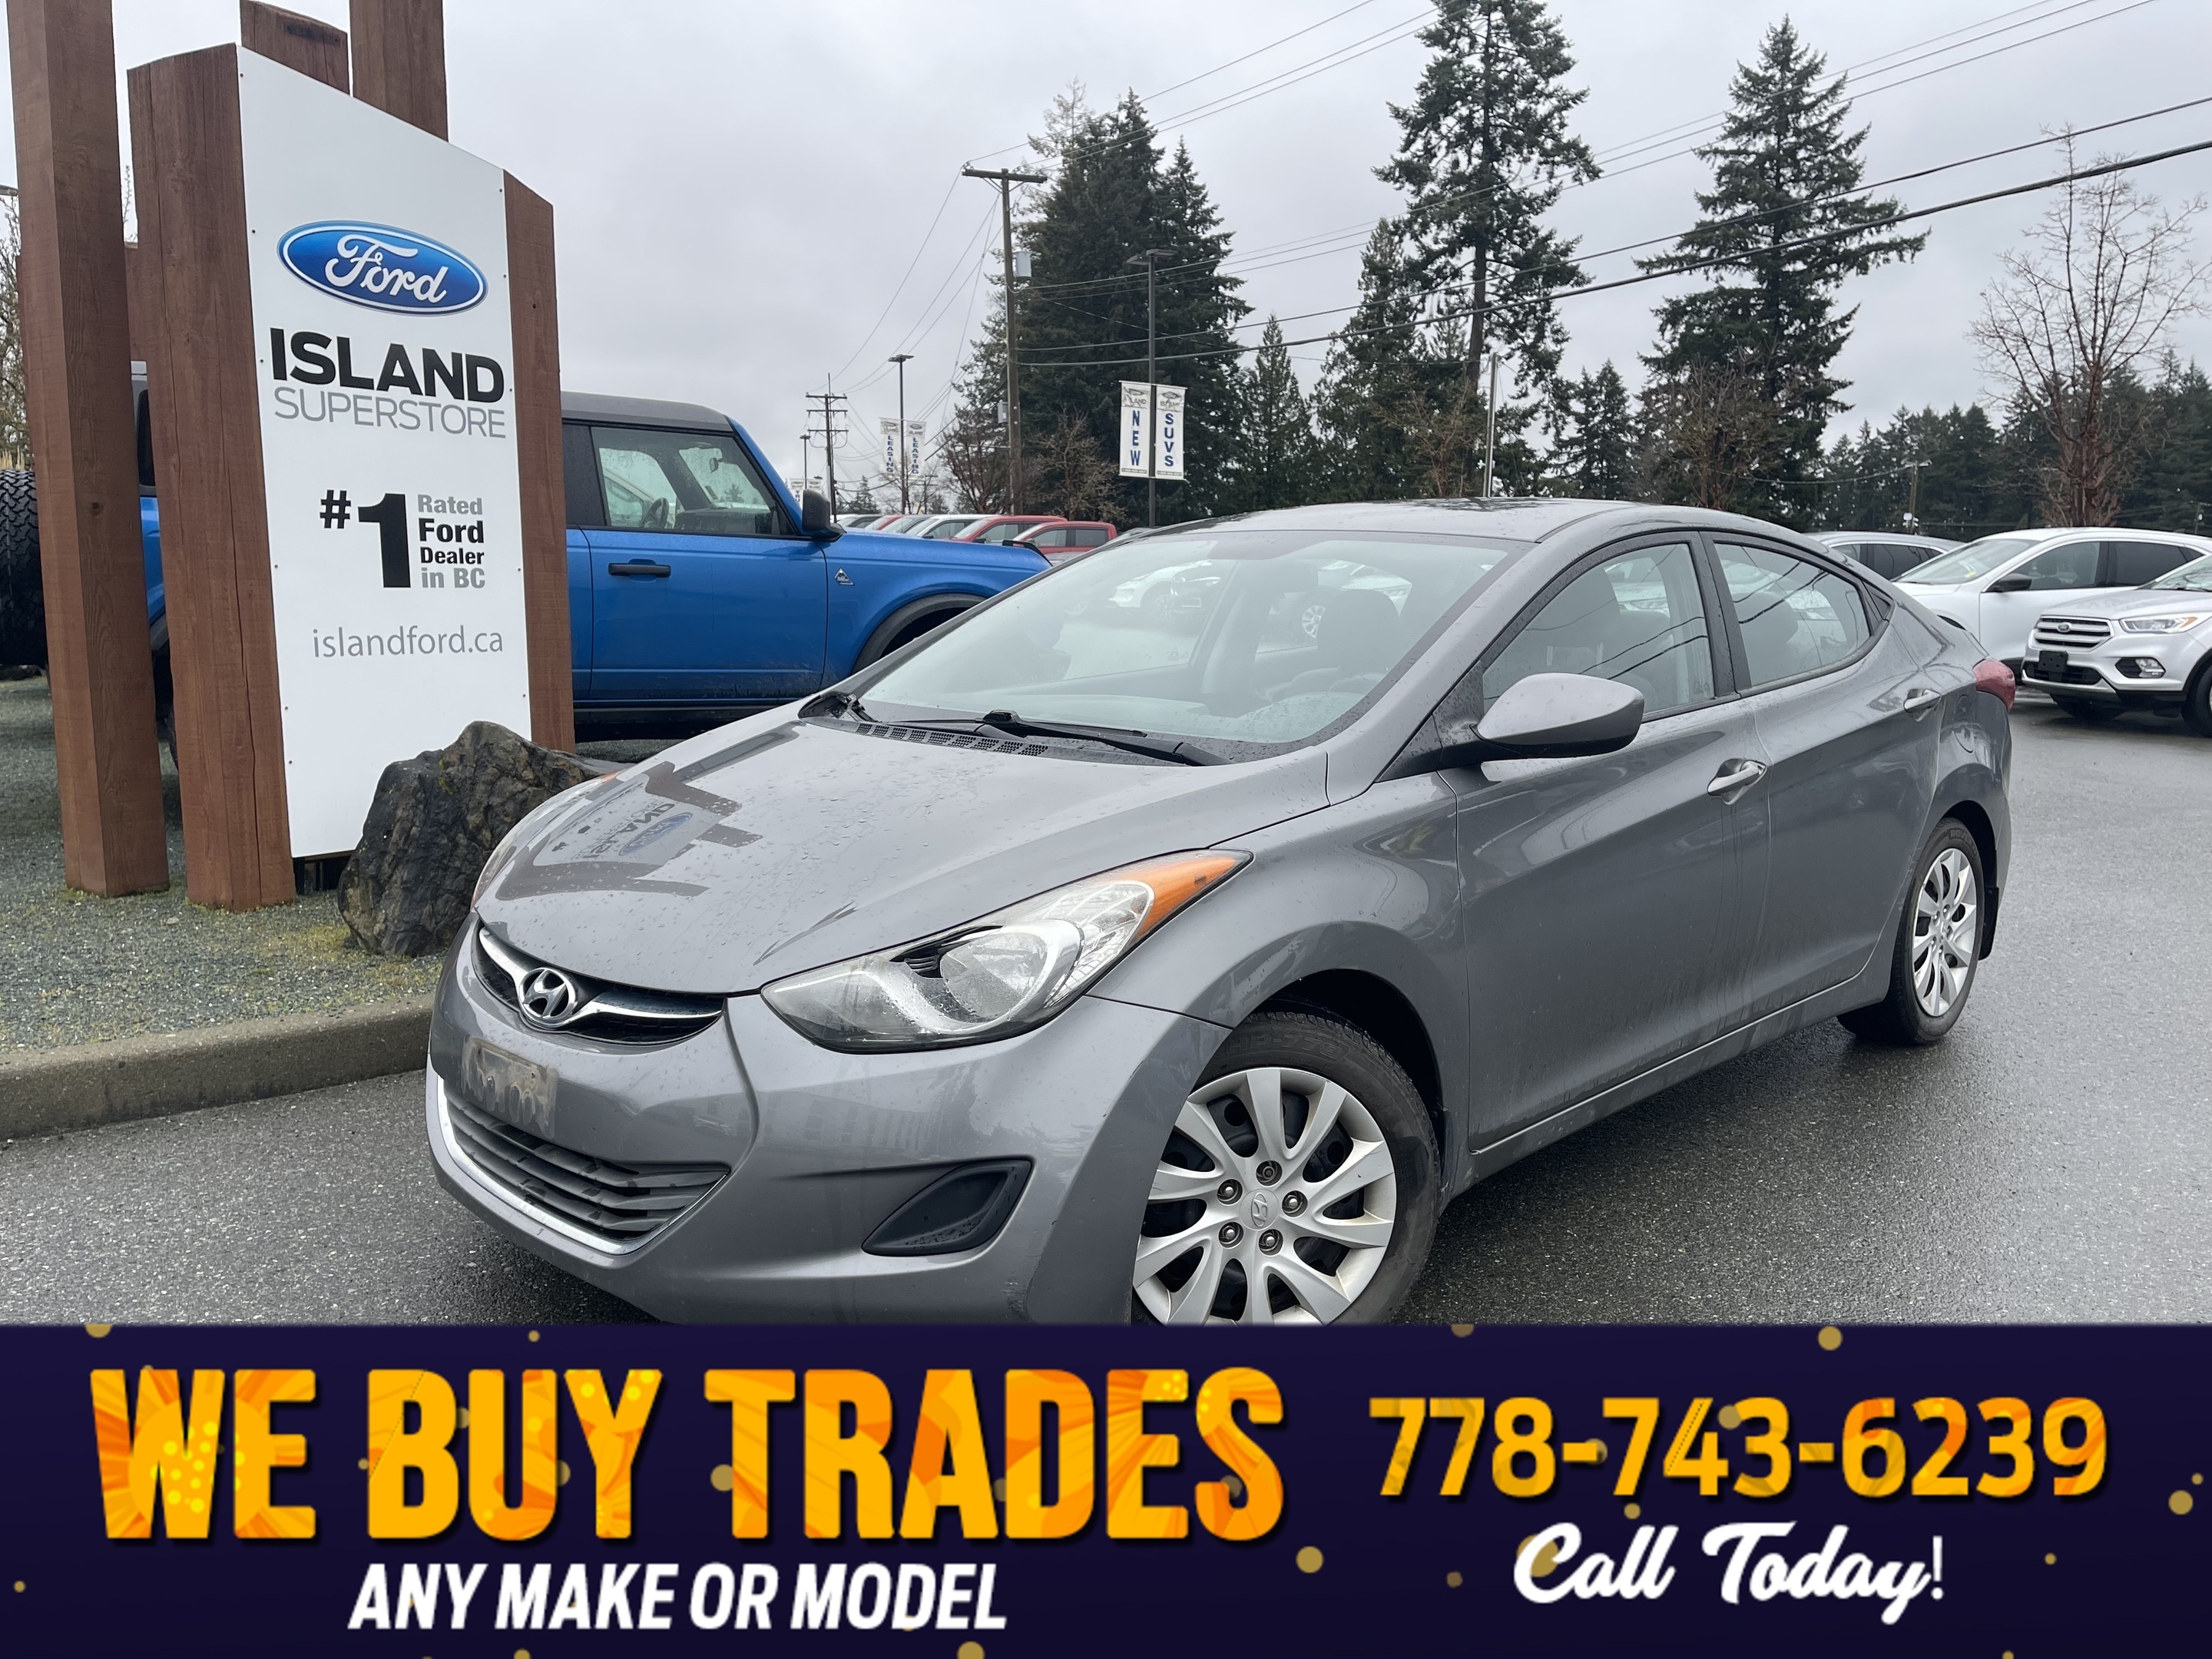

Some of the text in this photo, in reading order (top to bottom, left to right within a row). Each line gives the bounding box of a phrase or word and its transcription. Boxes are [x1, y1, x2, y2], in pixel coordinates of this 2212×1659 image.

[325, 233, 449, 303] Ford
[270, 327, 505, 403] ISLAND
[273, 386, 506, 439] SUPERSTORE
[1131, 410, 1141, 466] NEW
[1164, 413, 1174, 467] SUVS
[417, 494, 482, 515] Rated
[419, 518, 485, 544] Ford
[320, 490, 412, 588] #1
[420, 546, 485, 565] Dealer
[422, 567, 485, 589] in BC
[313, 625, 503, 658] islandford.ca
